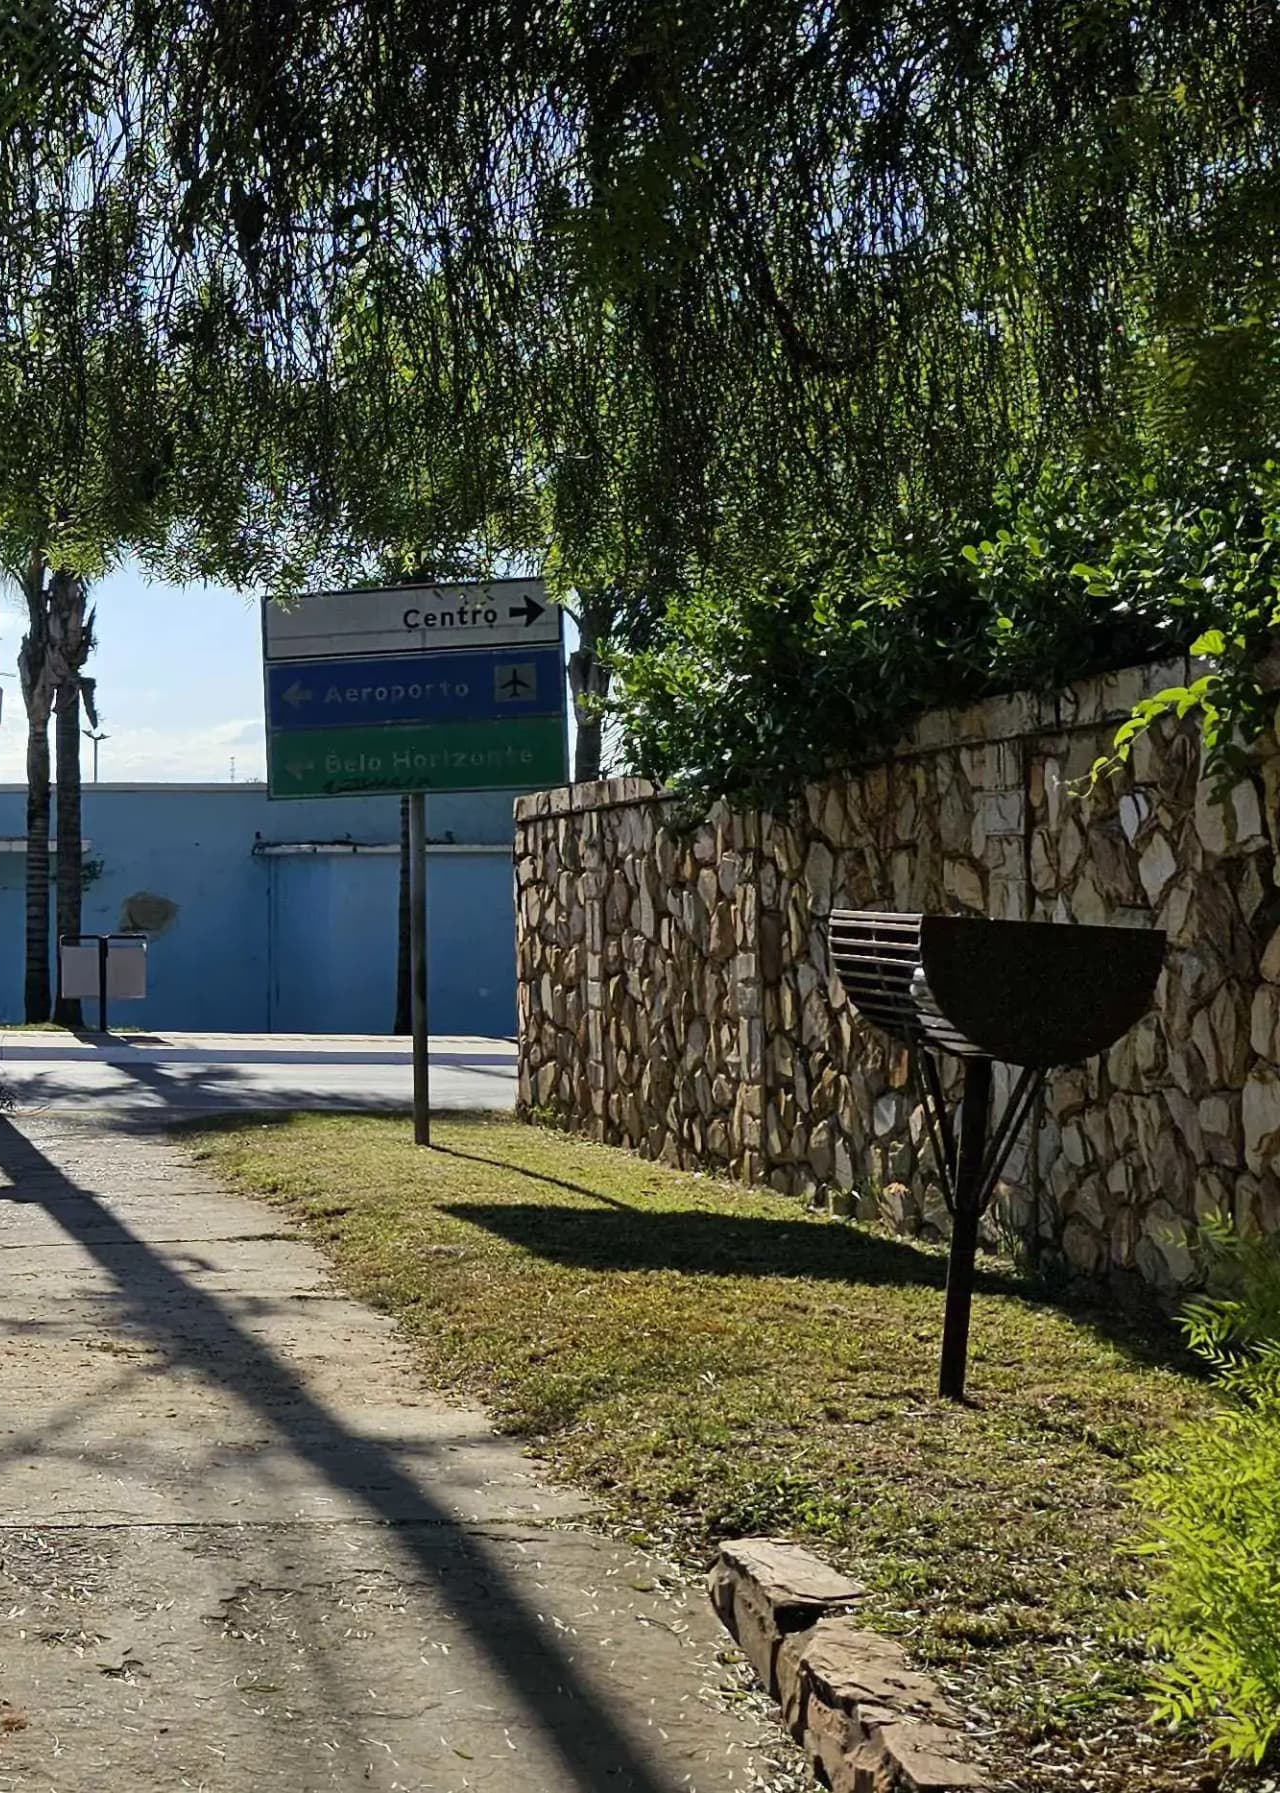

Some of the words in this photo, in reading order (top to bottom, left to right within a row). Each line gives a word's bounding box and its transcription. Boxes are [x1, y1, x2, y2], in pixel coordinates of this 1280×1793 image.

[403, 605, 498, 628] Centro
[324, 681, 470, 705] Aeroporto
[324, 751, 382, 774] Belo
[391, 745, 535, 770] Horizonte
